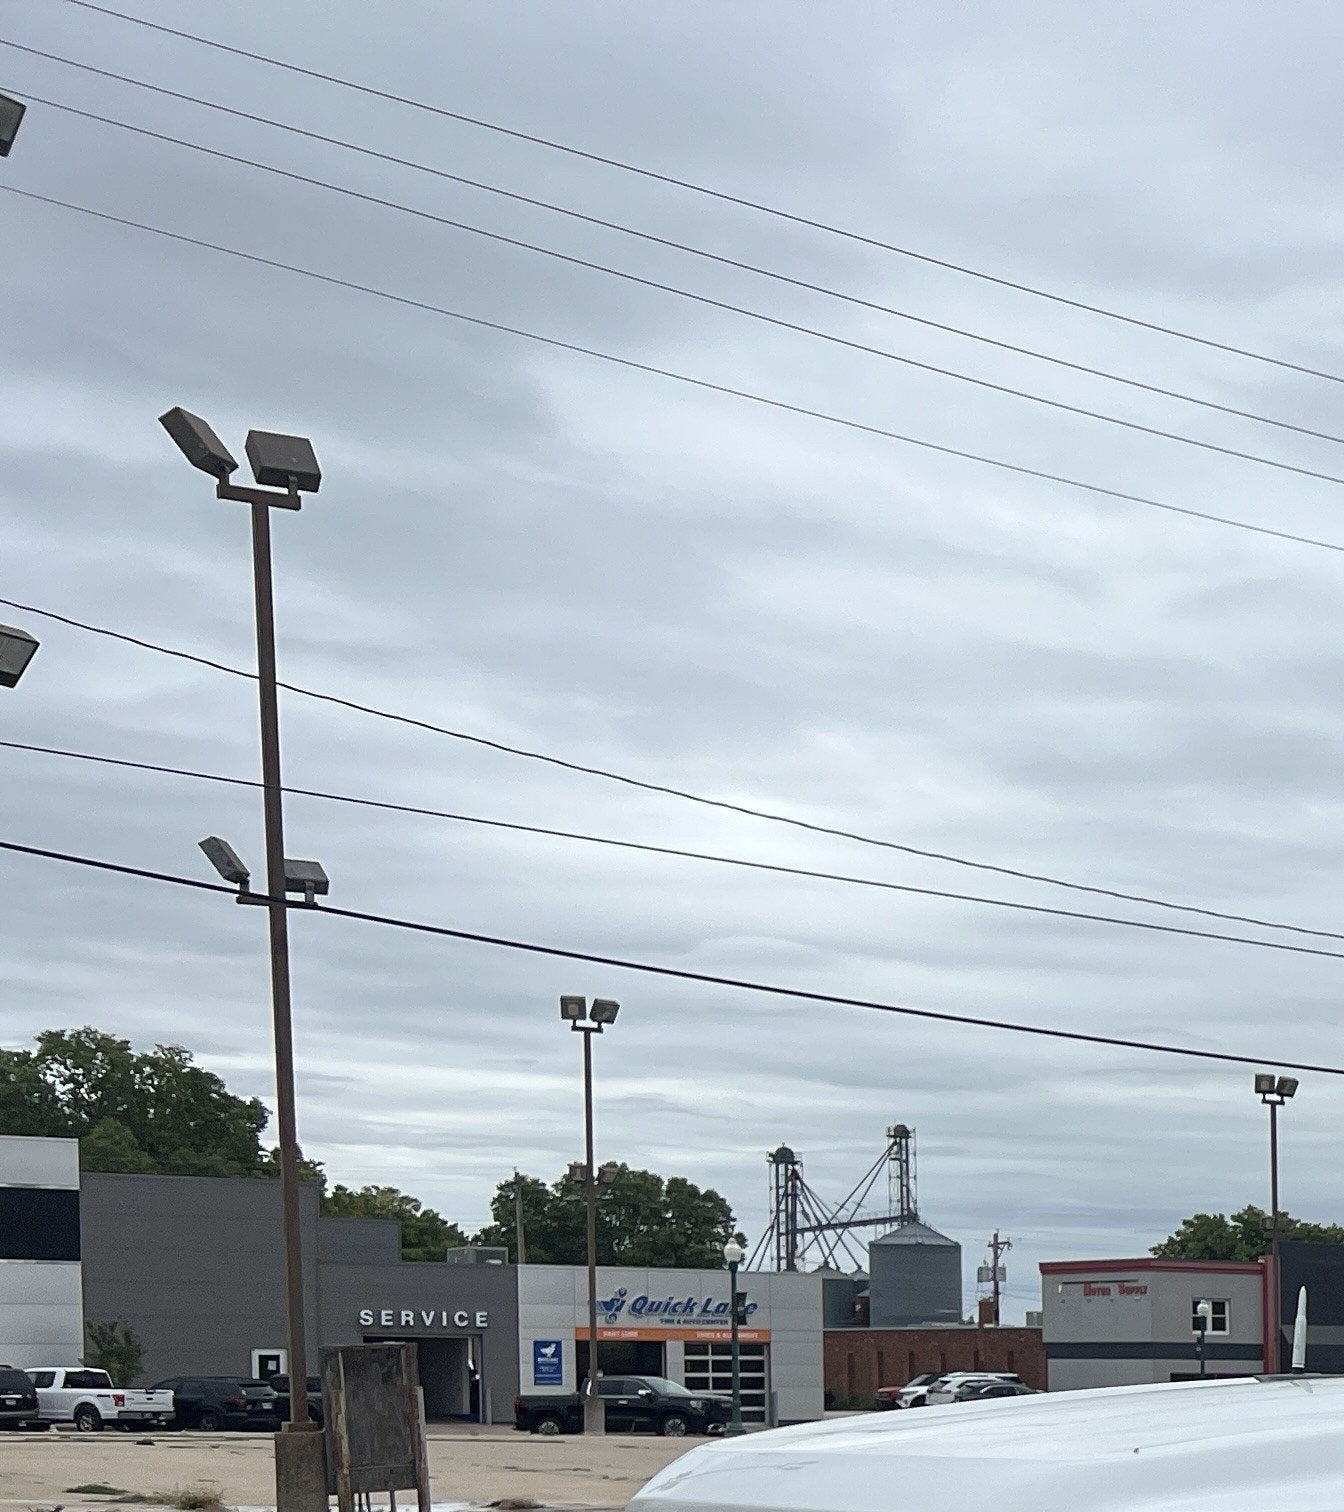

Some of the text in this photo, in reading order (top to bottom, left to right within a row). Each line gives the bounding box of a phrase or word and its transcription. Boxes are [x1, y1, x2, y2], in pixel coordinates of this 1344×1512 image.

[630, 1295, 758, 1316] Quick Lae
[359, 1309, 488, 1328] SERVICE
